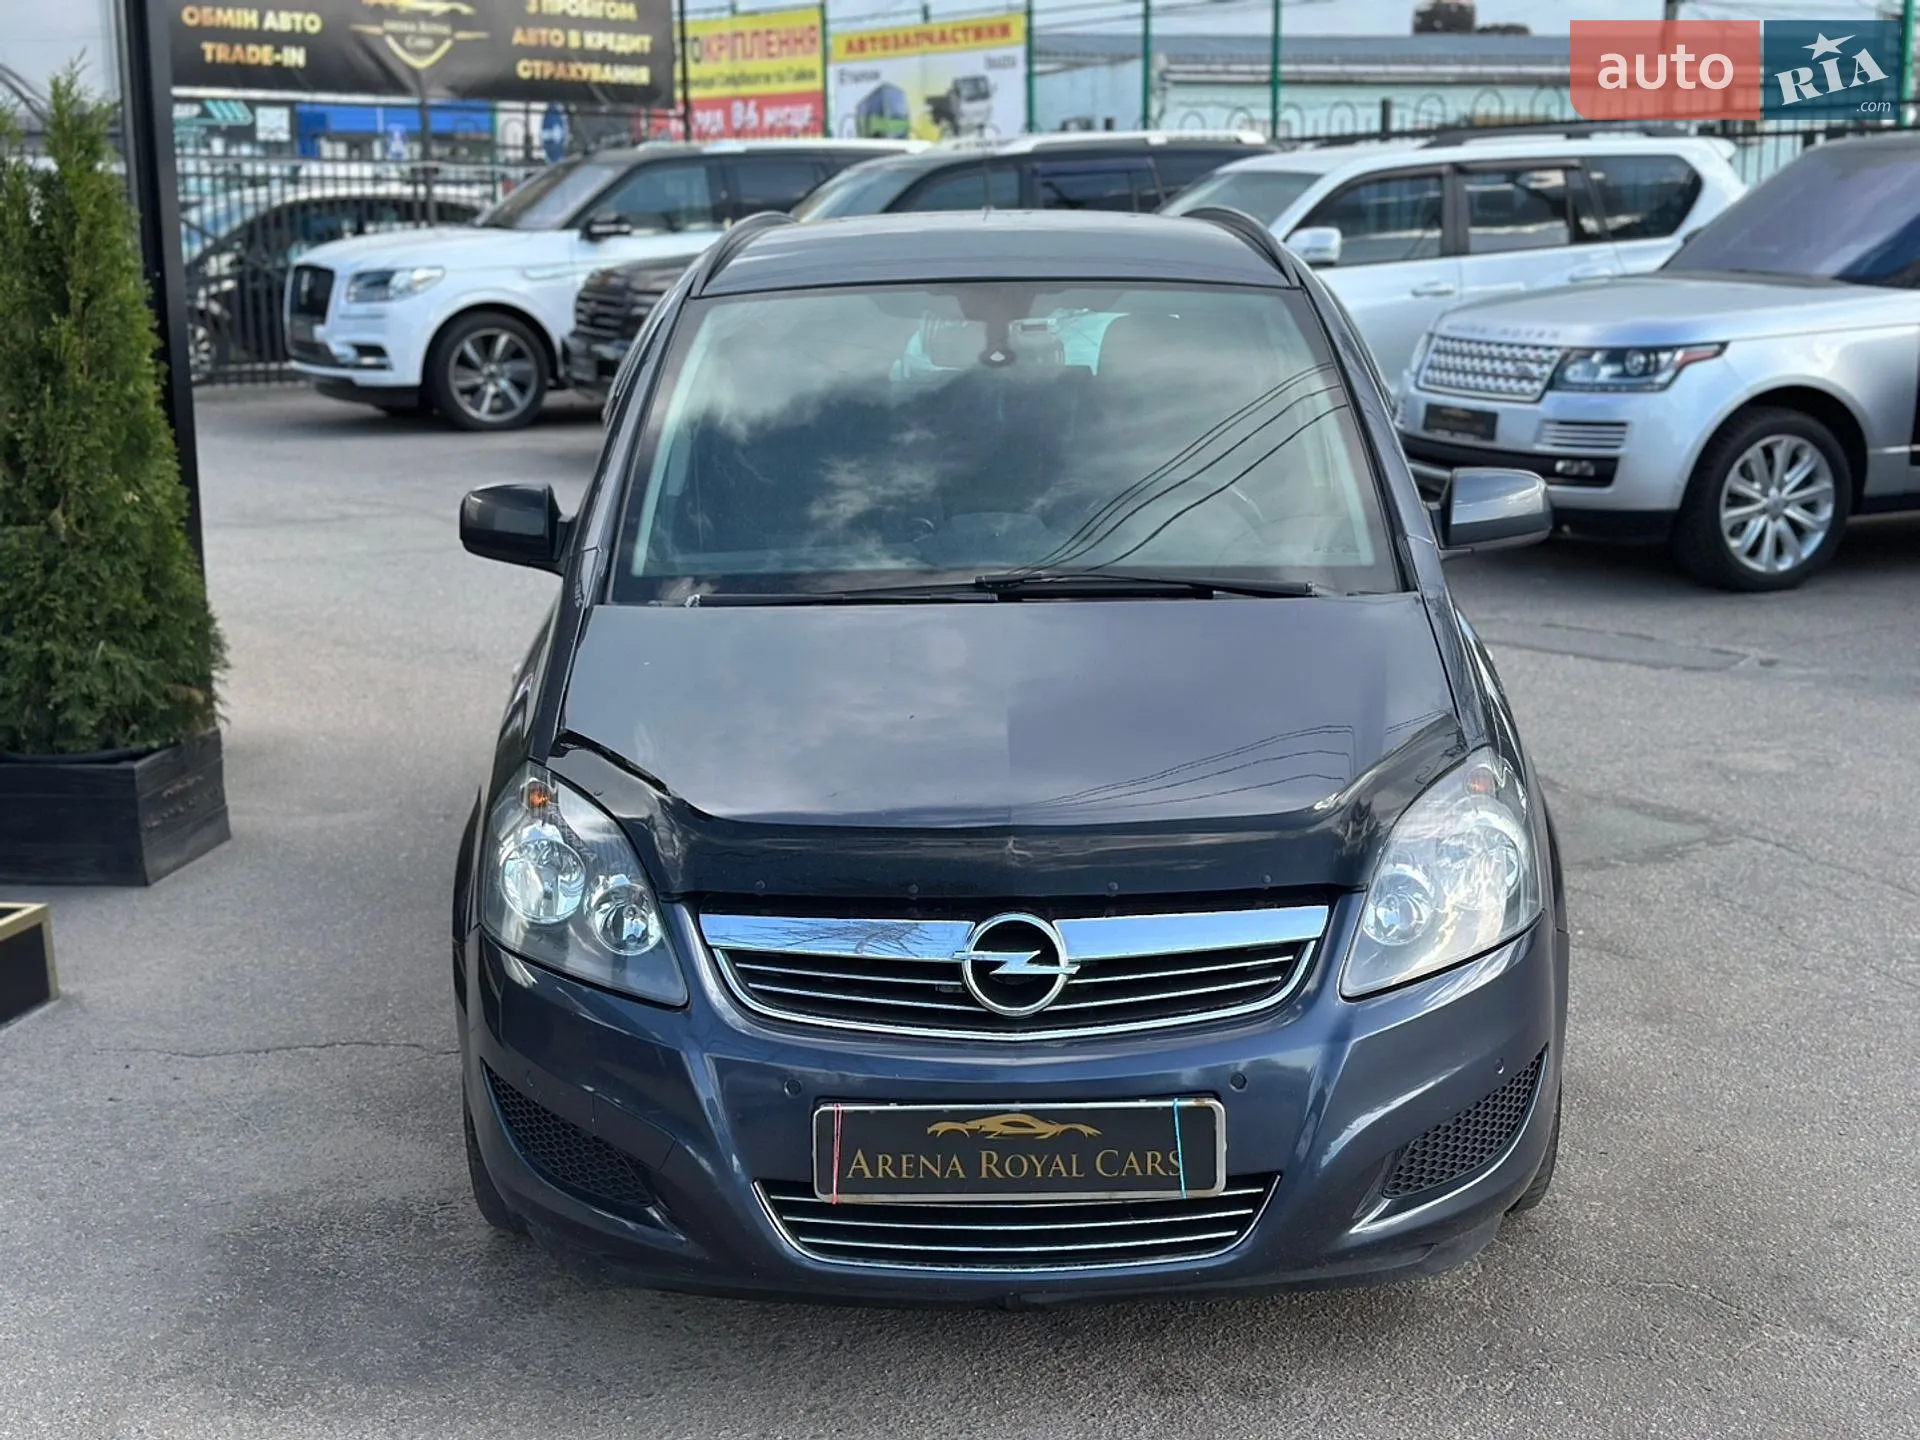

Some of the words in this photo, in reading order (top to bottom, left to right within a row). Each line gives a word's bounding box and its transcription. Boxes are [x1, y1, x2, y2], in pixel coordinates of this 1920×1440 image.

[181, 5, 259, 29] ОБМІН
[262, 10, 323, 34] АВТО
[512, 27, 565, 48] АВТО
[583, 31, 653, 54] КРЕДИТ
[844, 22, 1012, 55] АВТОЗАПЧАСТИНИ
[201, 41, 307, 67] TRADE-IN
[516, 58, 651, 85] СТРАХУВАННЯ
[846, 1149, 966, 1180] ARENA
[979, 1149, 1085, 1179] ROYAL
[1095, 1148, 1184, 1177] CARS
